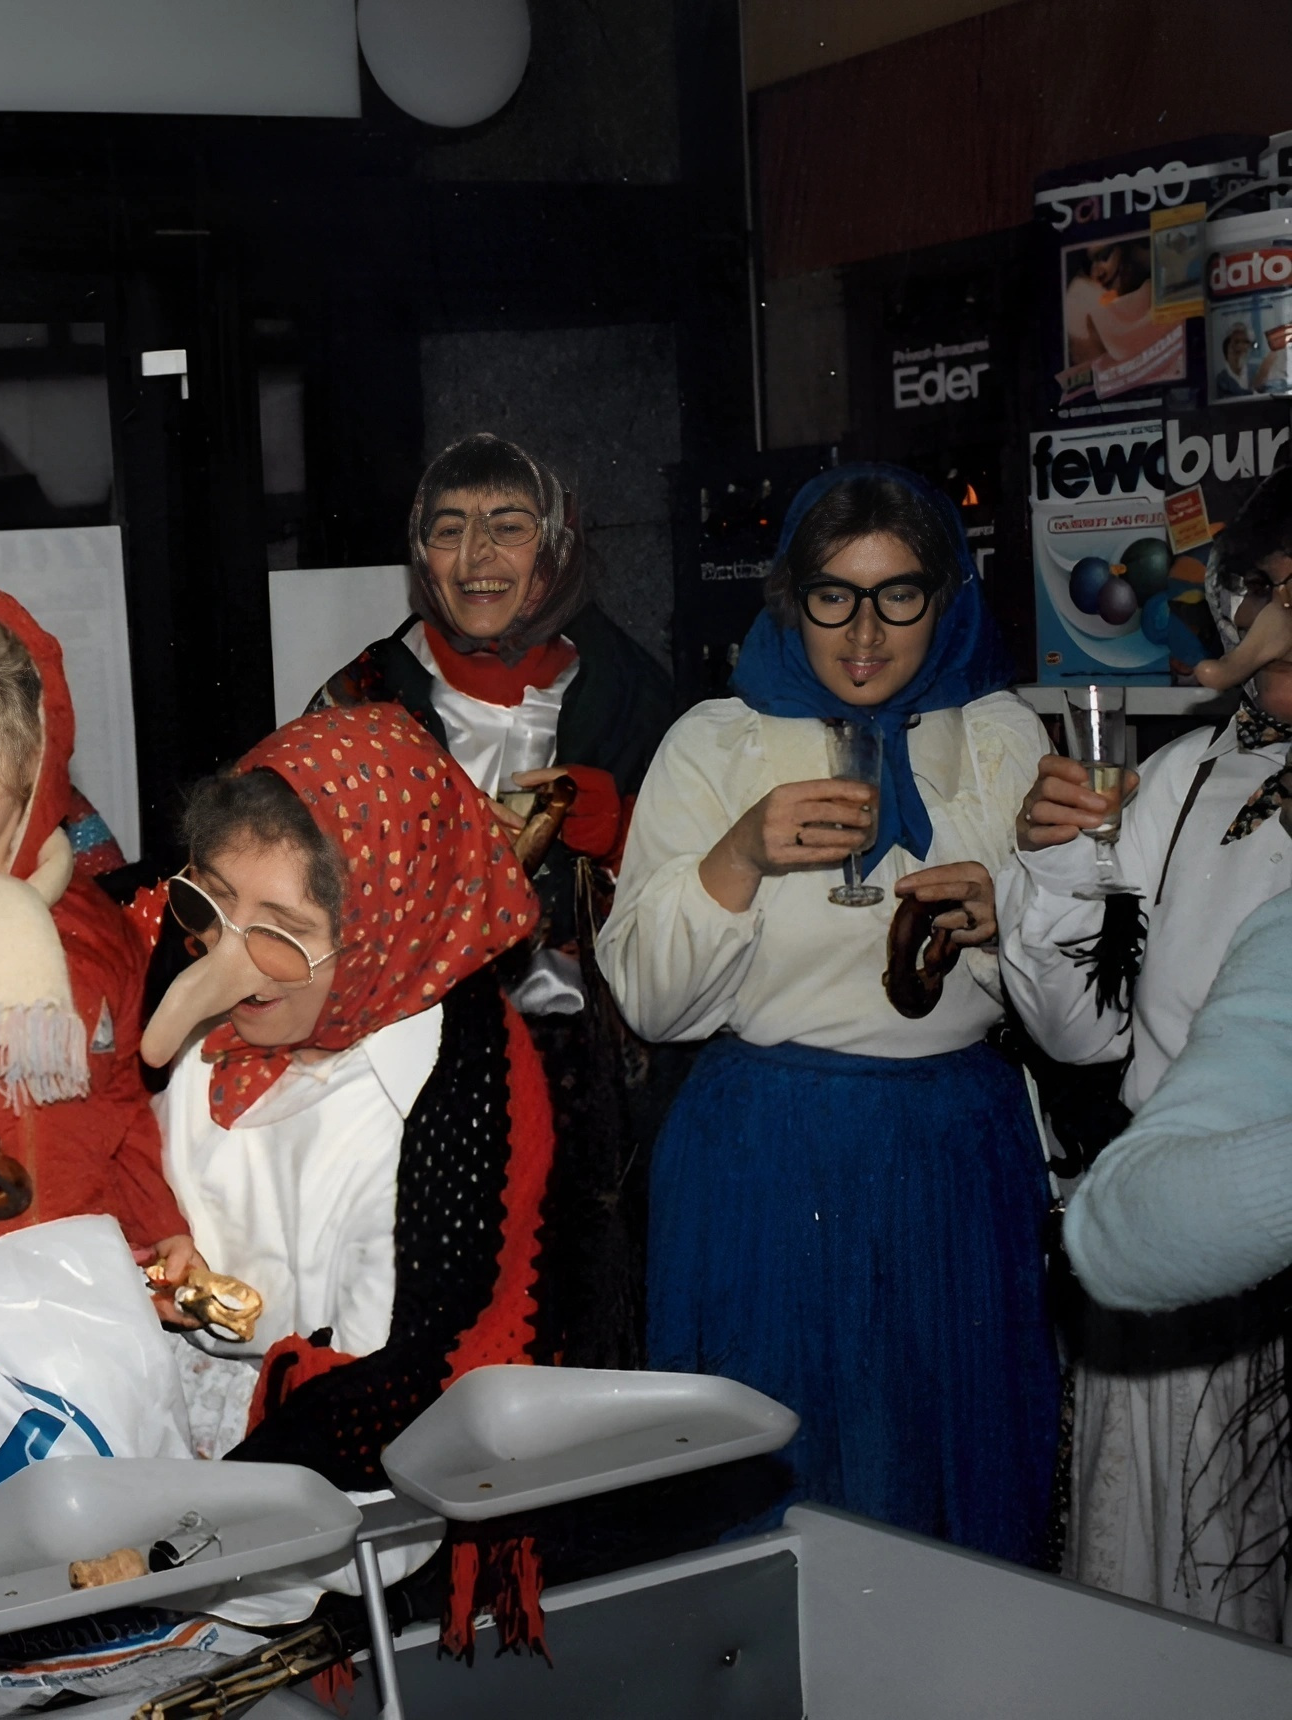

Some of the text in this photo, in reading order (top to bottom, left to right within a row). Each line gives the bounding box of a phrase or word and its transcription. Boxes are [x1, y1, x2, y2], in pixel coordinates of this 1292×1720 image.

[1051, 161, 1190, 231] sanso
[1210, 251, 1292, 291] dato
[893, 361, 990, 409] Eder
